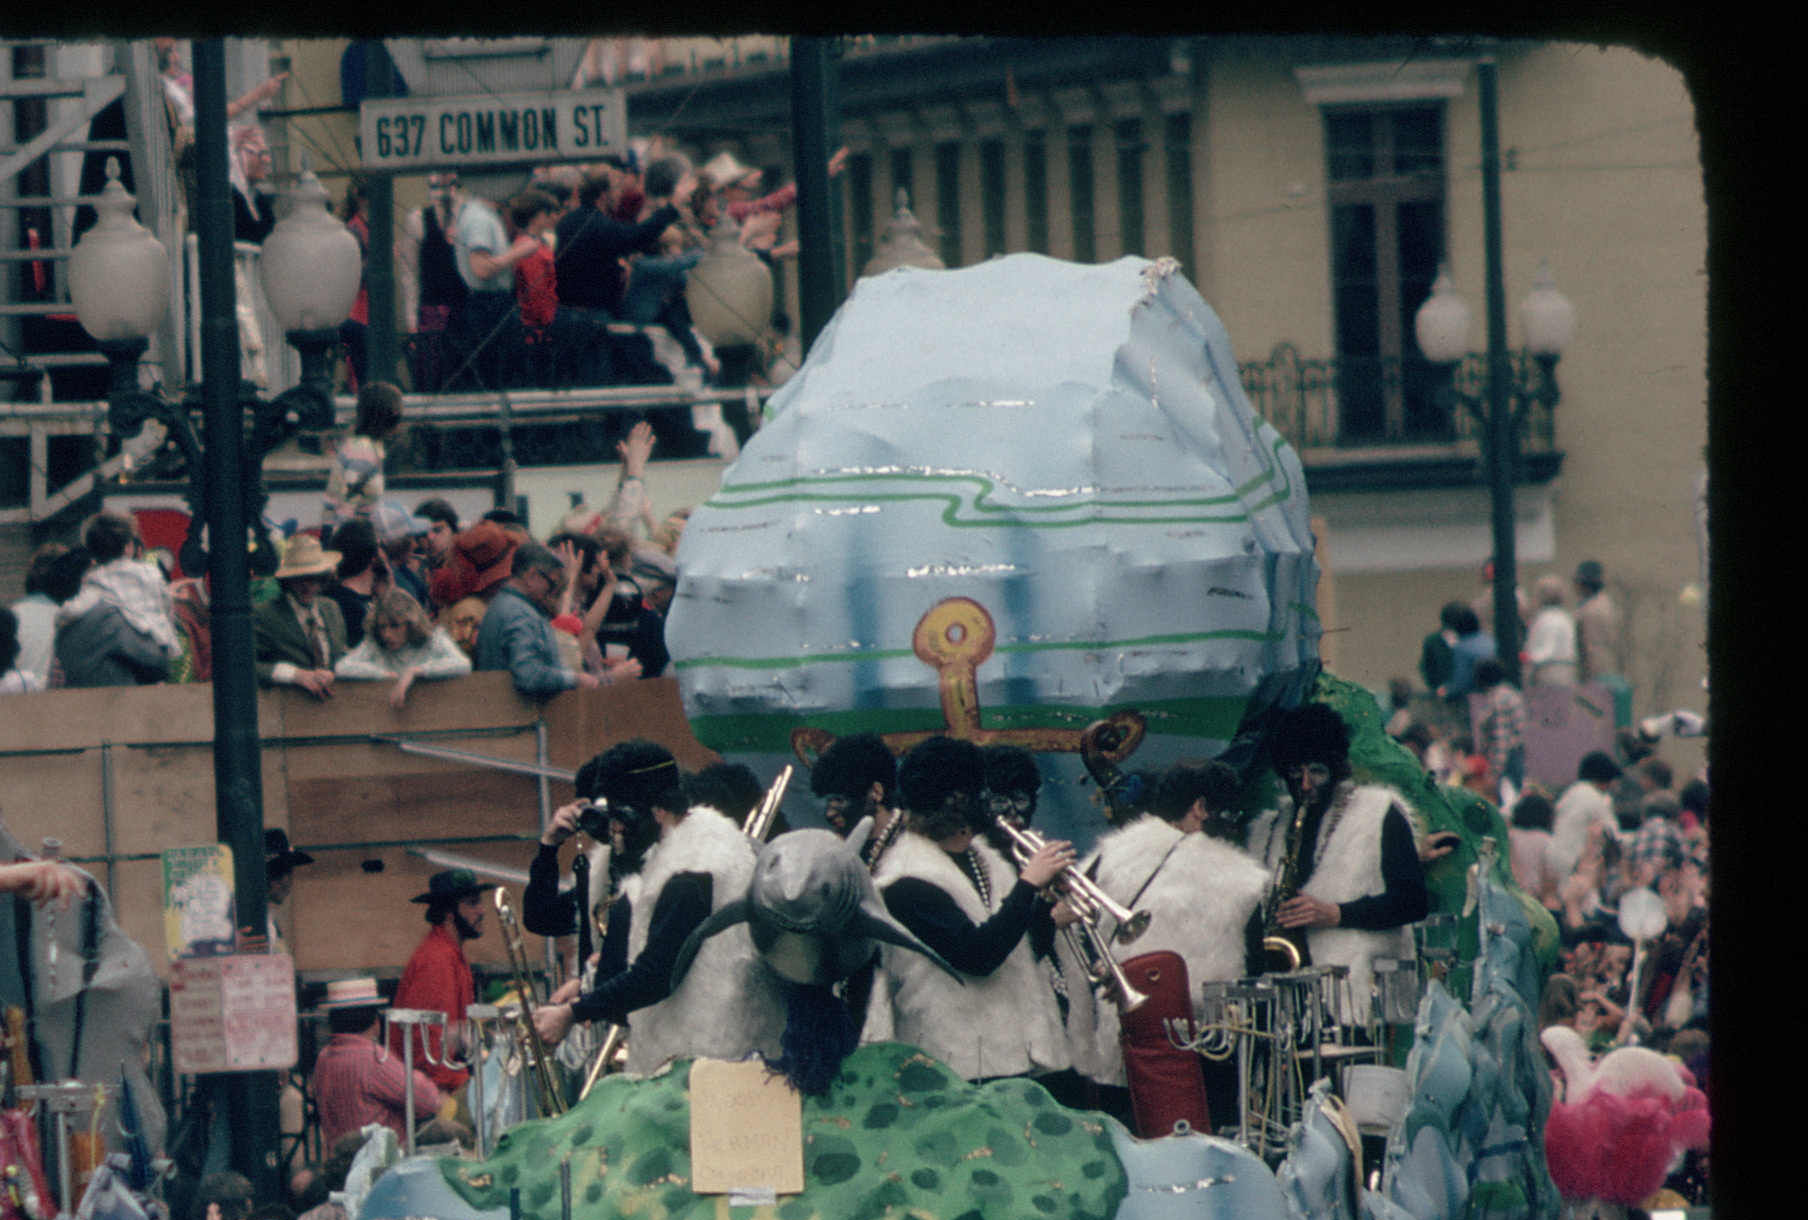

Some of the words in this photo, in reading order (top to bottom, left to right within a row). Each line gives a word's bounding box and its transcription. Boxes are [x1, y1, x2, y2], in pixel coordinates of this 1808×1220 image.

[376, 114, 426, 158] 637
[439, 106, 558, 155] COMMON
[573, 104, 609, 147] ST.
